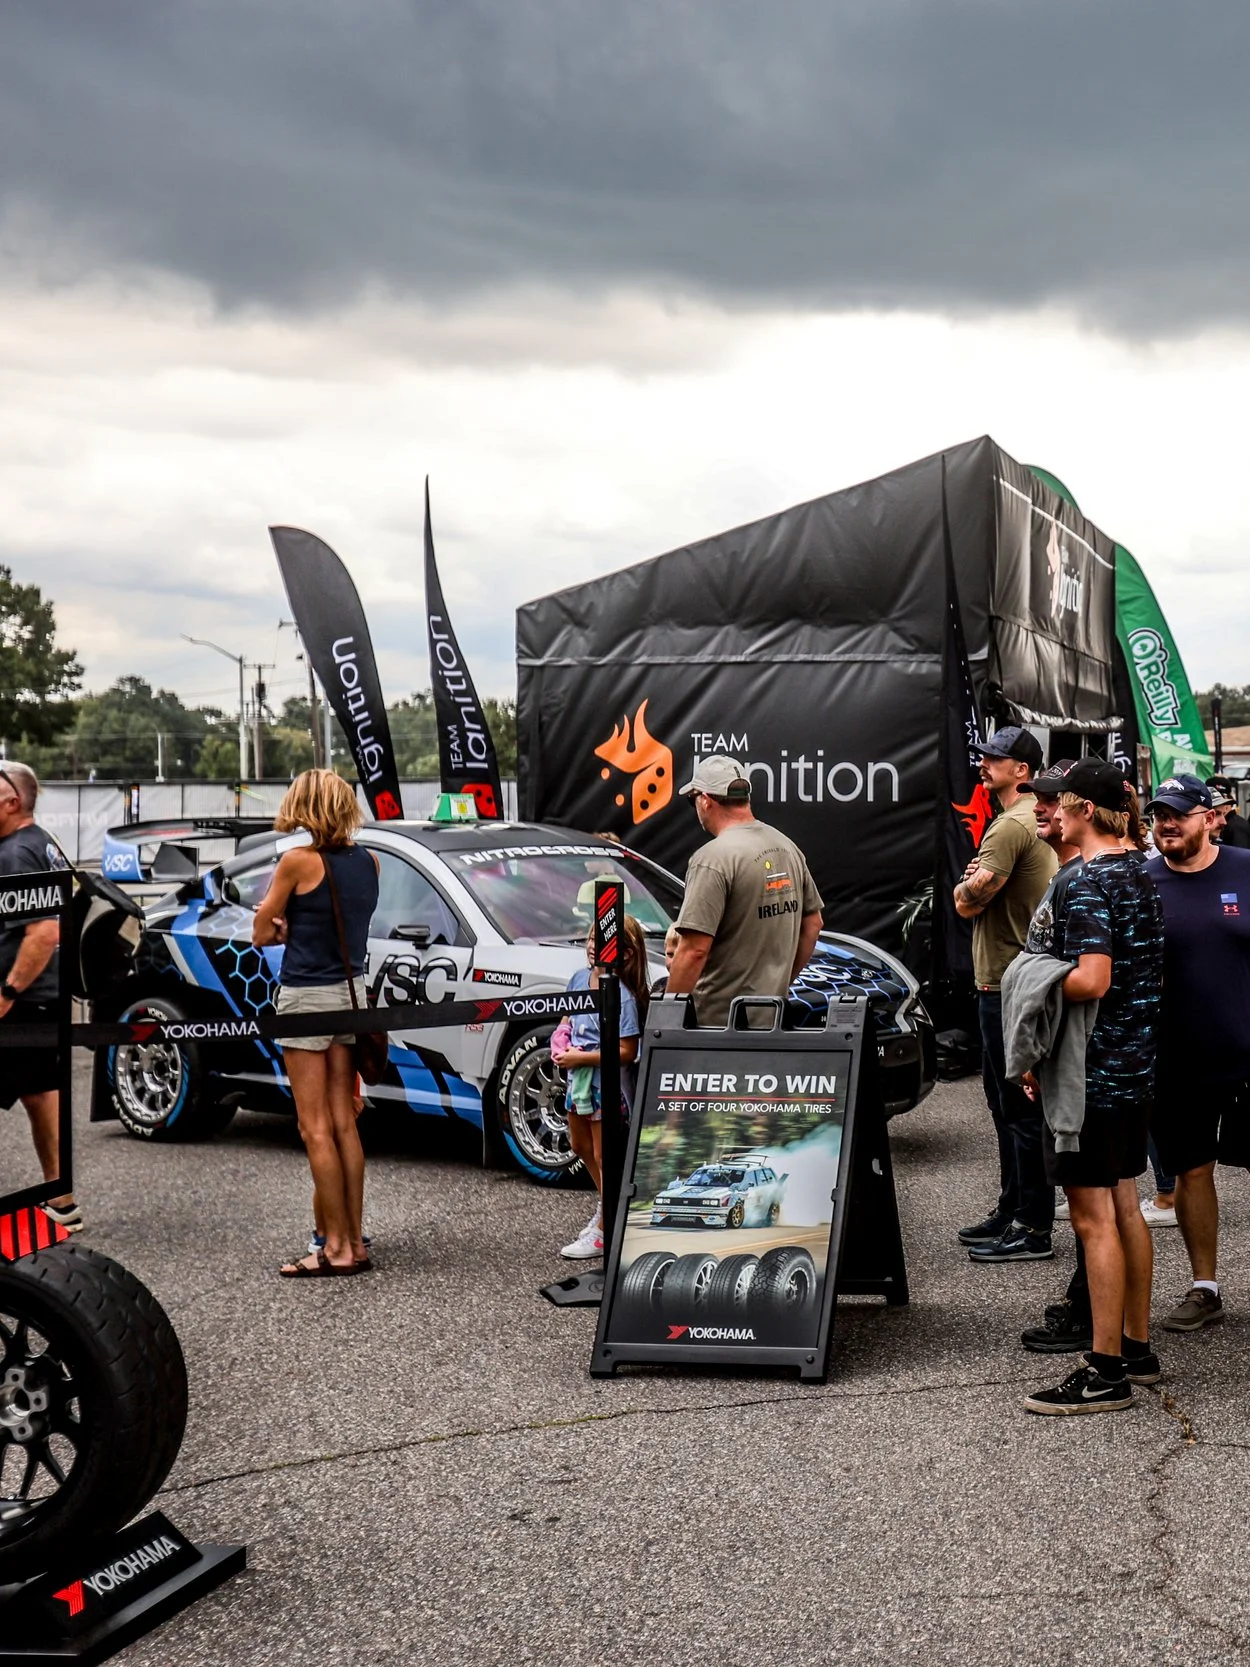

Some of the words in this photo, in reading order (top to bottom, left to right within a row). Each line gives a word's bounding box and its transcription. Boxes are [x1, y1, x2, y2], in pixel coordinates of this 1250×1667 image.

[1129, 628, 1180, 727] O'Reilly
[448, 724, 464, 769] TEAM
[691, 733, 748, 751] TEAM
[693, 750, 899, 802] nition
[459, 846, 625, 866] NITROCROSS
[600, 908, 616, 931] ENTER
[603, 922, 617, 942] HERE
[484, 971, 520, 985] YOKOHAMA
[503, 995, 595, 1016] YOKOHAMA
[160, 1021, 260, 1038] YOKOHAMA
[499, 1036, 537, 1104] ADVAN
[659, 1073, 737, 1092] ENTER
[745, 1075, 778, 1093] TO
[786, 1075, 836, 1094] WIN
[657, 1102, 666, 1111] A
[667, 1102, 687, 1111] SET
[690, 1102, 705, 1111] OF
[708, 1102, 737, 1112] FOUR
[739, 1103, 801, 1113] YOKOHAMA
[804, 1104, 832, 1114] TIRES
[688, 1327, 756, 1340] YOKOHAMA
[83, 1535, 180, 1595] YOKOHAMA
